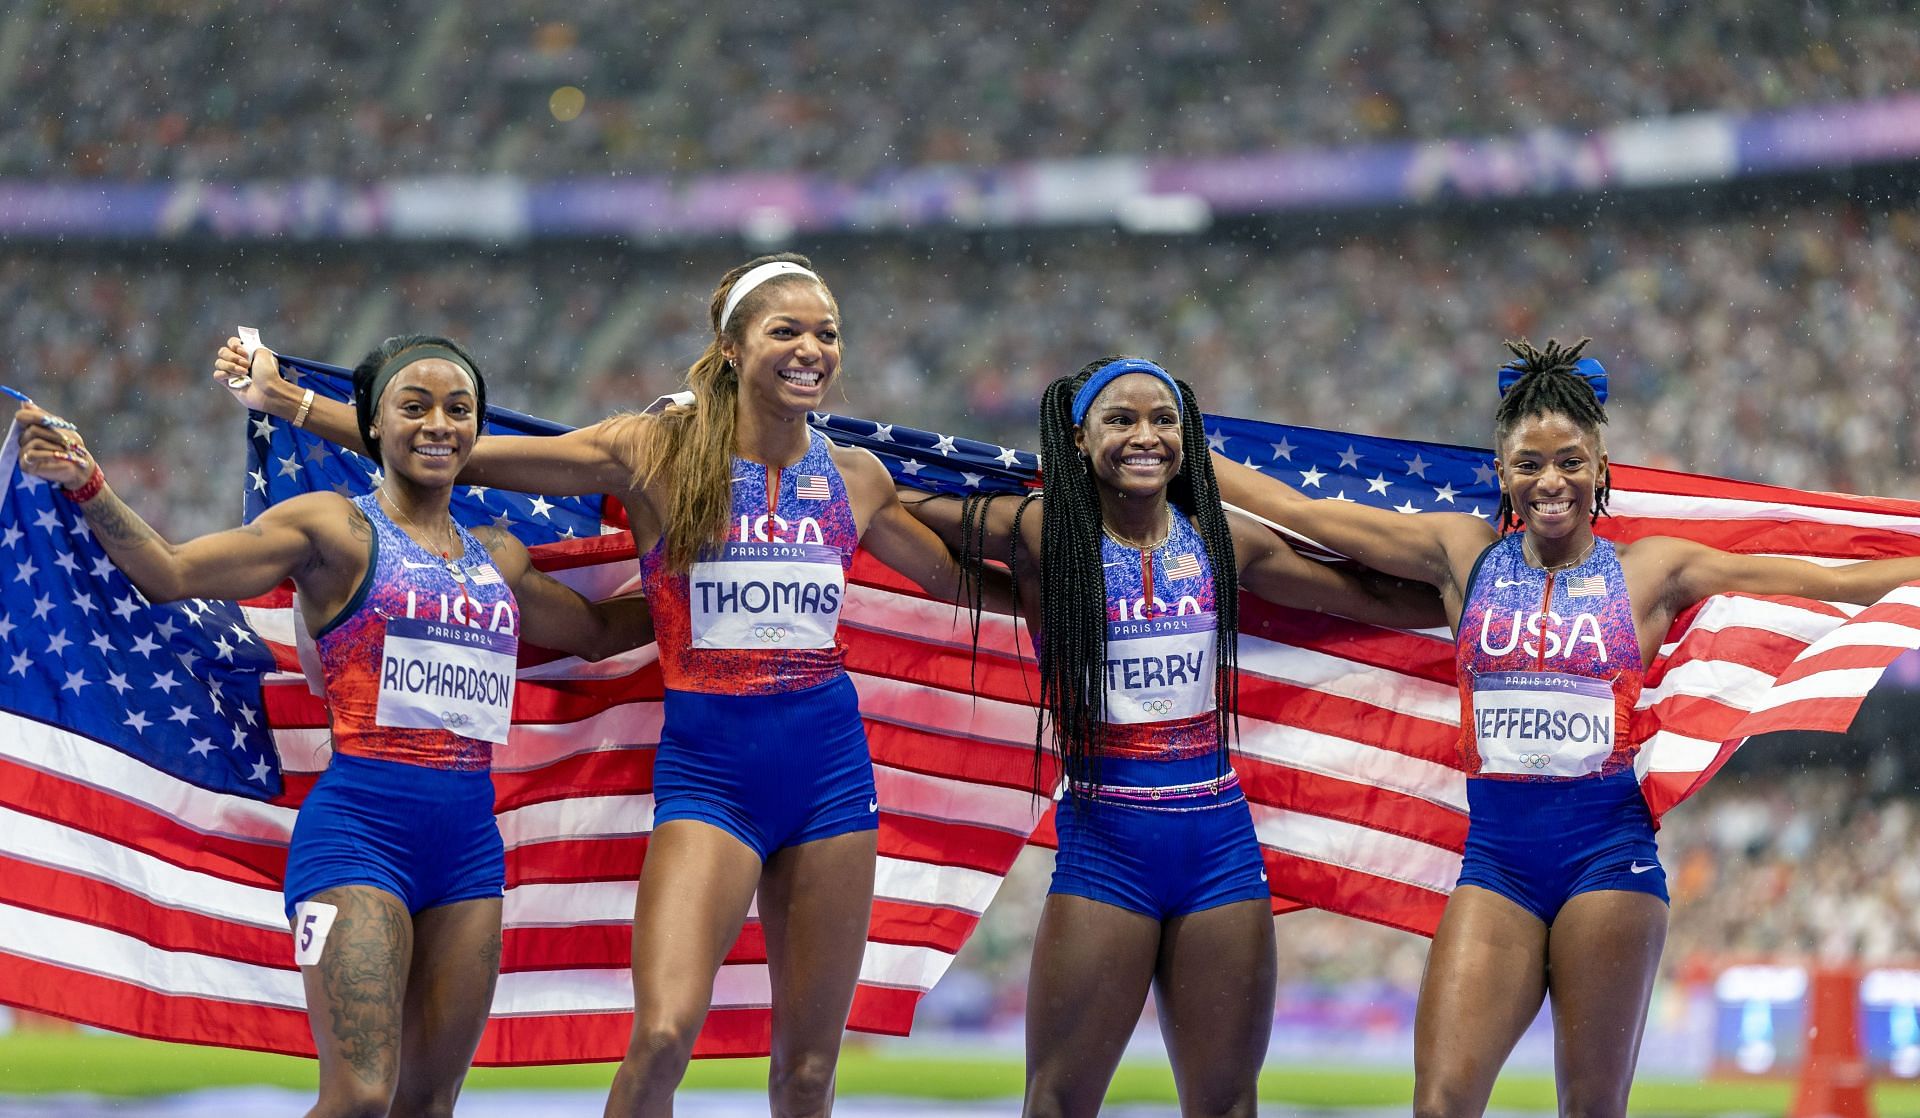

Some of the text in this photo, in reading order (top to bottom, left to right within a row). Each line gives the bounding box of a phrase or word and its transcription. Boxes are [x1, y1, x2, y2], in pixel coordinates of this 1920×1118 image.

[731, 547, 805, 557] PARIS 2024
[695, 581, 840, 614] THOMAS
[427, 625, 493, 646] PARIS 2024
[1114, 621, 1188, 635] PARIS 2024
[1481, 608, 1608, 663] USA
[383, 656, 510, 708] RICHARDSON
[1103, 651, 1204, 691] TERRY
[1505, 676, 1577, 689] PARIS 2024
[301, 915, 317, 952] 5
